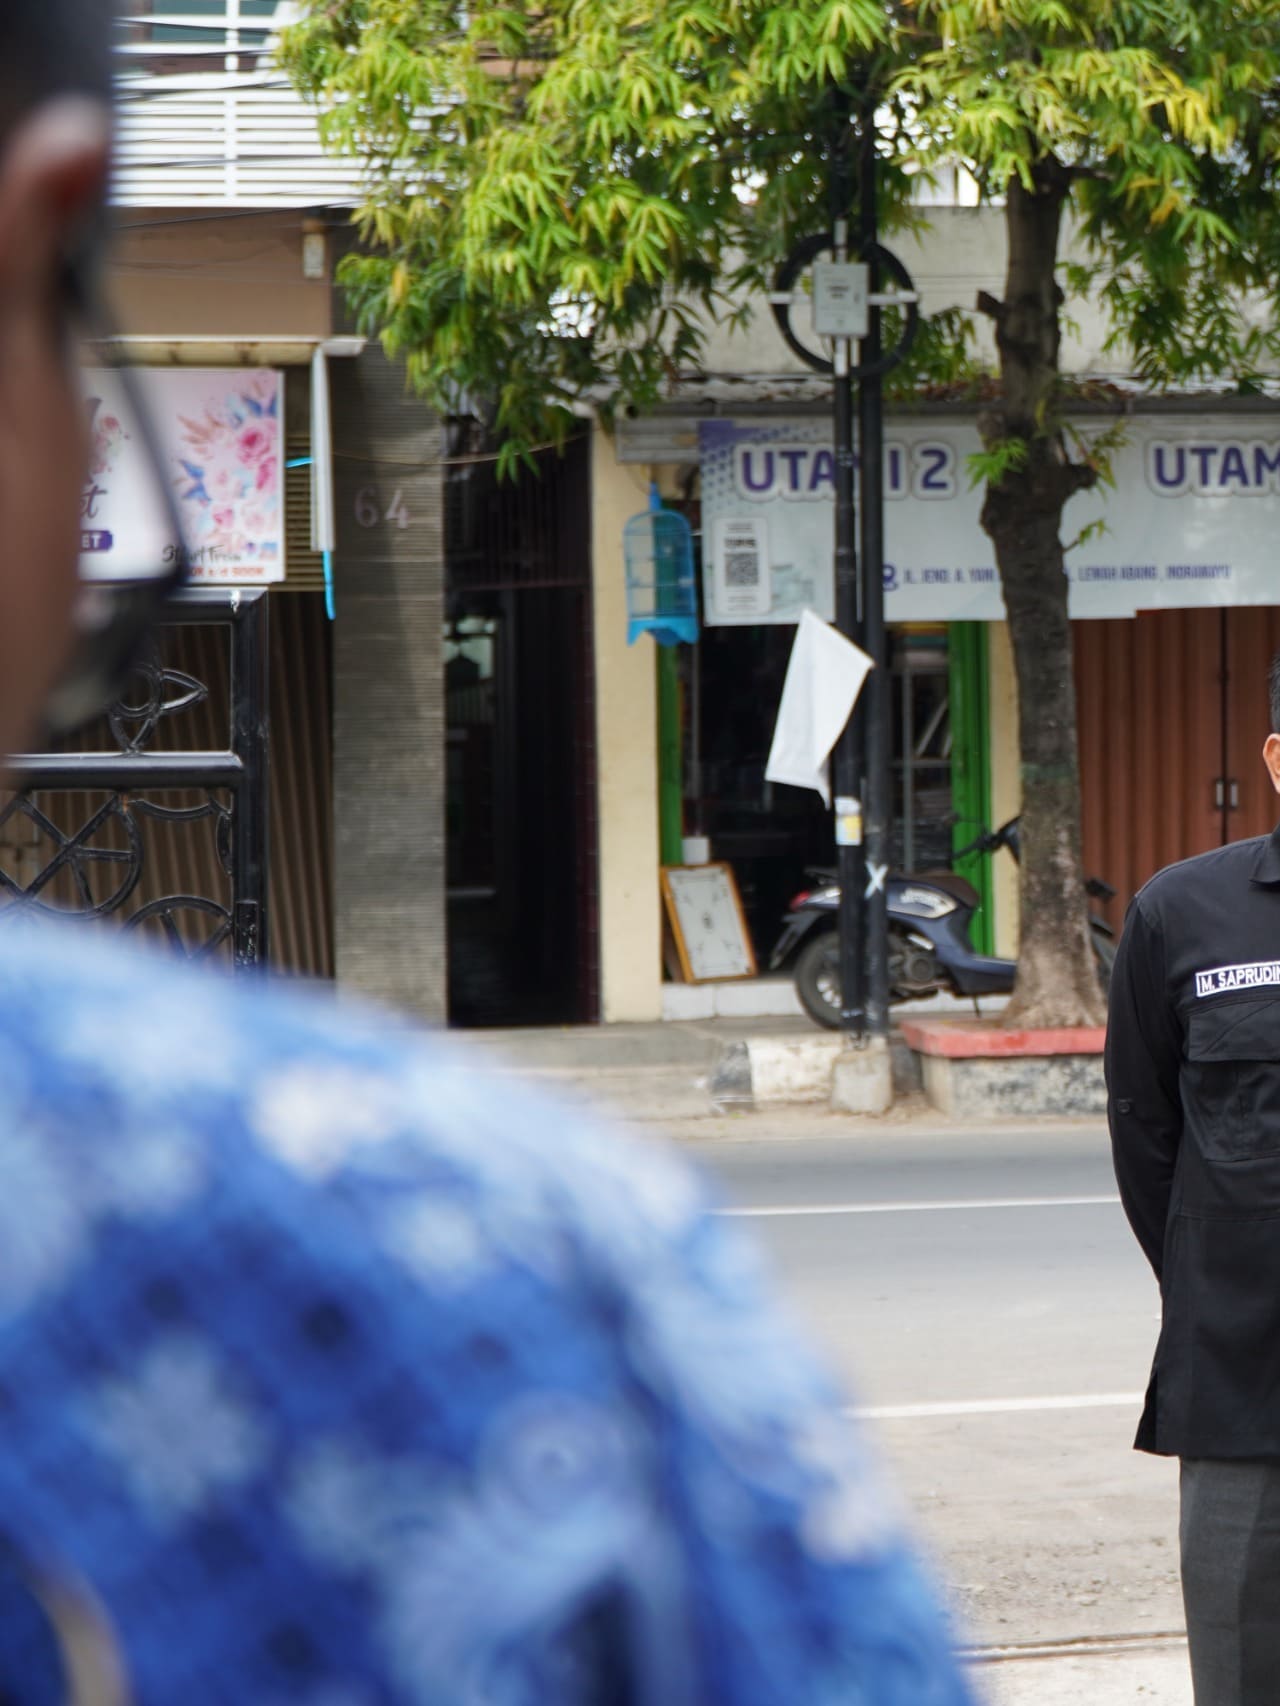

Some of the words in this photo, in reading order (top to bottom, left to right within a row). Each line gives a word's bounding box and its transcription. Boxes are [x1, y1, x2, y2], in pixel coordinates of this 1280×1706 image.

[742, 449, 900, 491] UTAI
[920, 448, 949, 491] 2
[354, 488, 409, 529] 64
[1201, 975, 1215, 992] M.
